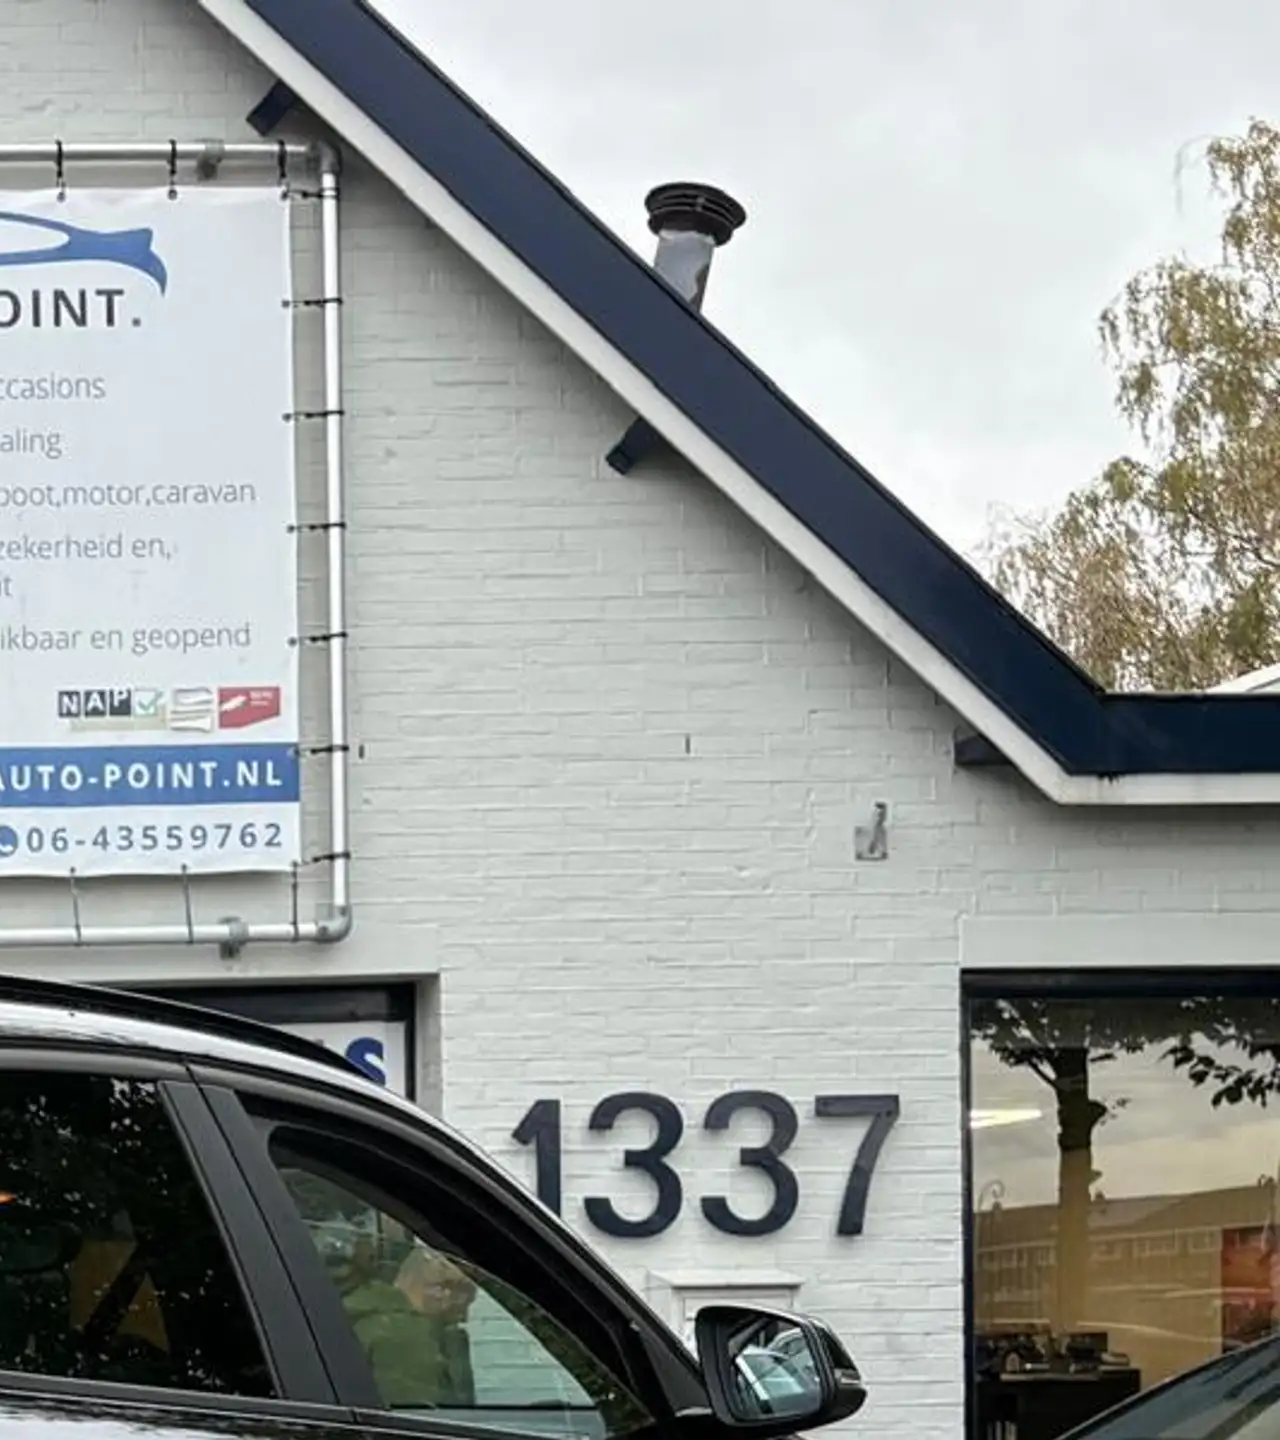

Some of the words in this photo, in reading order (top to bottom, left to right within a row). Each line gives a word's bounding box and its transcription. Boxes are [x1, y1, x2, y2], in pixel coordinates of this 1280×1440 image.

[90, 629, 123, 650] en
[131, 622, 251, 657] geopend
[58, 688, 132, 718] NAP
[26, 822, 283, 853] 06-43559762
[511, 1090, 900, 1238] 1337
